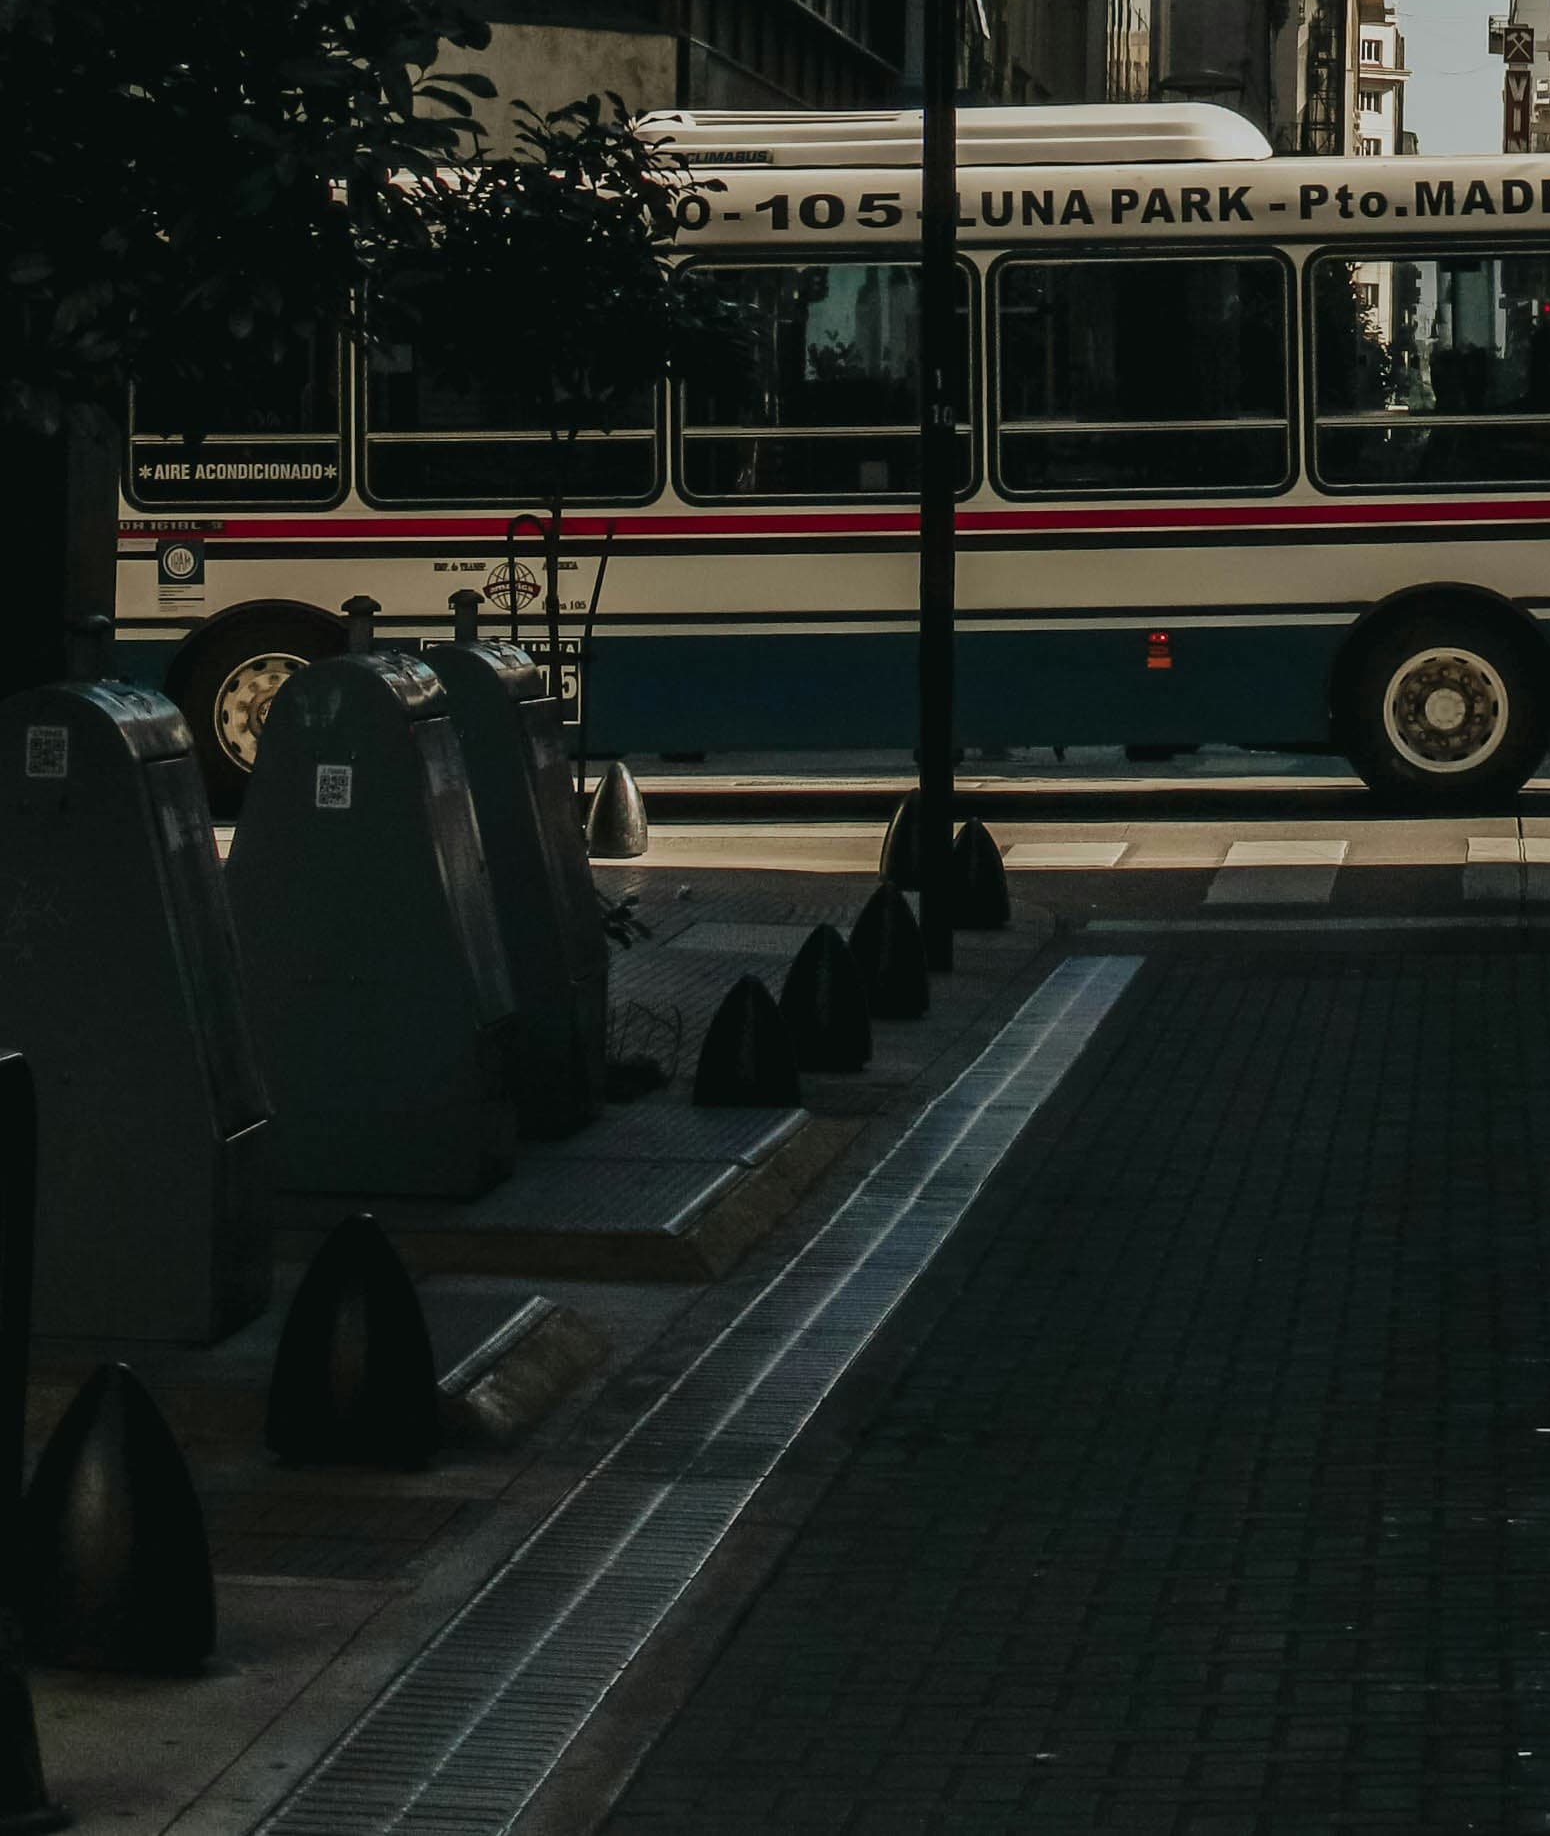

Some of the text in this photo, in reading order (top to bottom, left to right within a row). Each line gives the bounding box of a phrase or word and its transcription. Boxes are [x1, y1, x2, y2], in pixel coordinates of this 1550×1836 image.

[687, 150, 767, 163] CLIMABUS
[755, 193, 903, 230] 105
[955, 190, 1094, 227] LUNA
[1111, 186, 1254, 224] PARK
[154, 463, 323, 479] AIRE ACONDICIONADO
